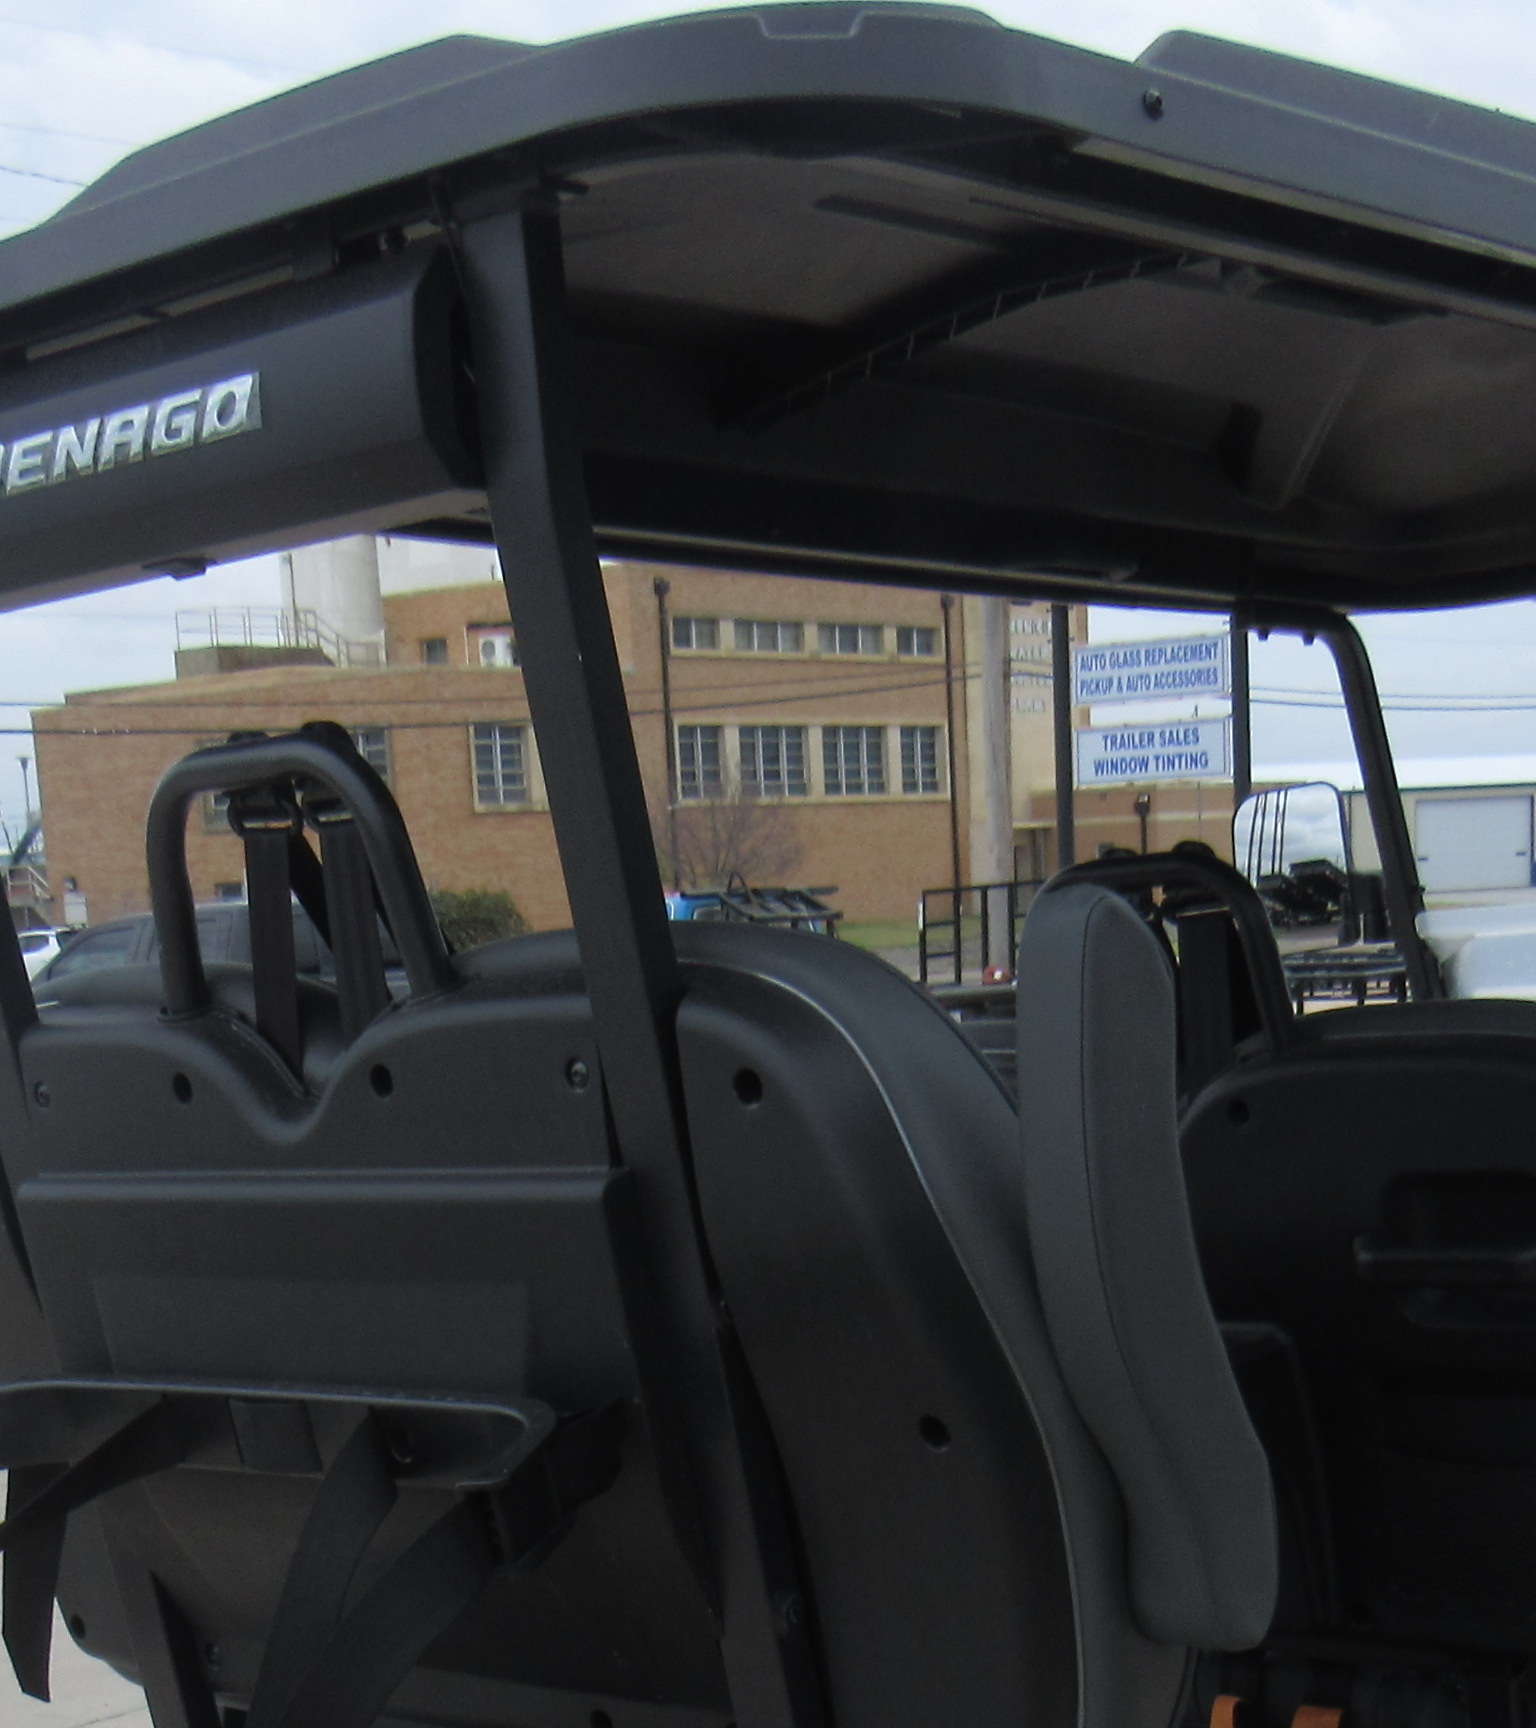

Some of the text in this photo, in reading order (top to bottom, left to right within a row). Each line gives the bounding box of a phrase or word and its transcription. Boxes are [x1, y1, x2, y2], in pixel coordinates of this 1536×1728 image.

[1080, 641, 1219, 672] AUTO GLASS REPLACEMENT
[1080, 667, 1218, 697] PICKUP & AUTO ACCESSORIES
[1102, 727, 1200, 752] TRAILER SALES
[1094, 751, 1209, 777] WINDOW TINTING
